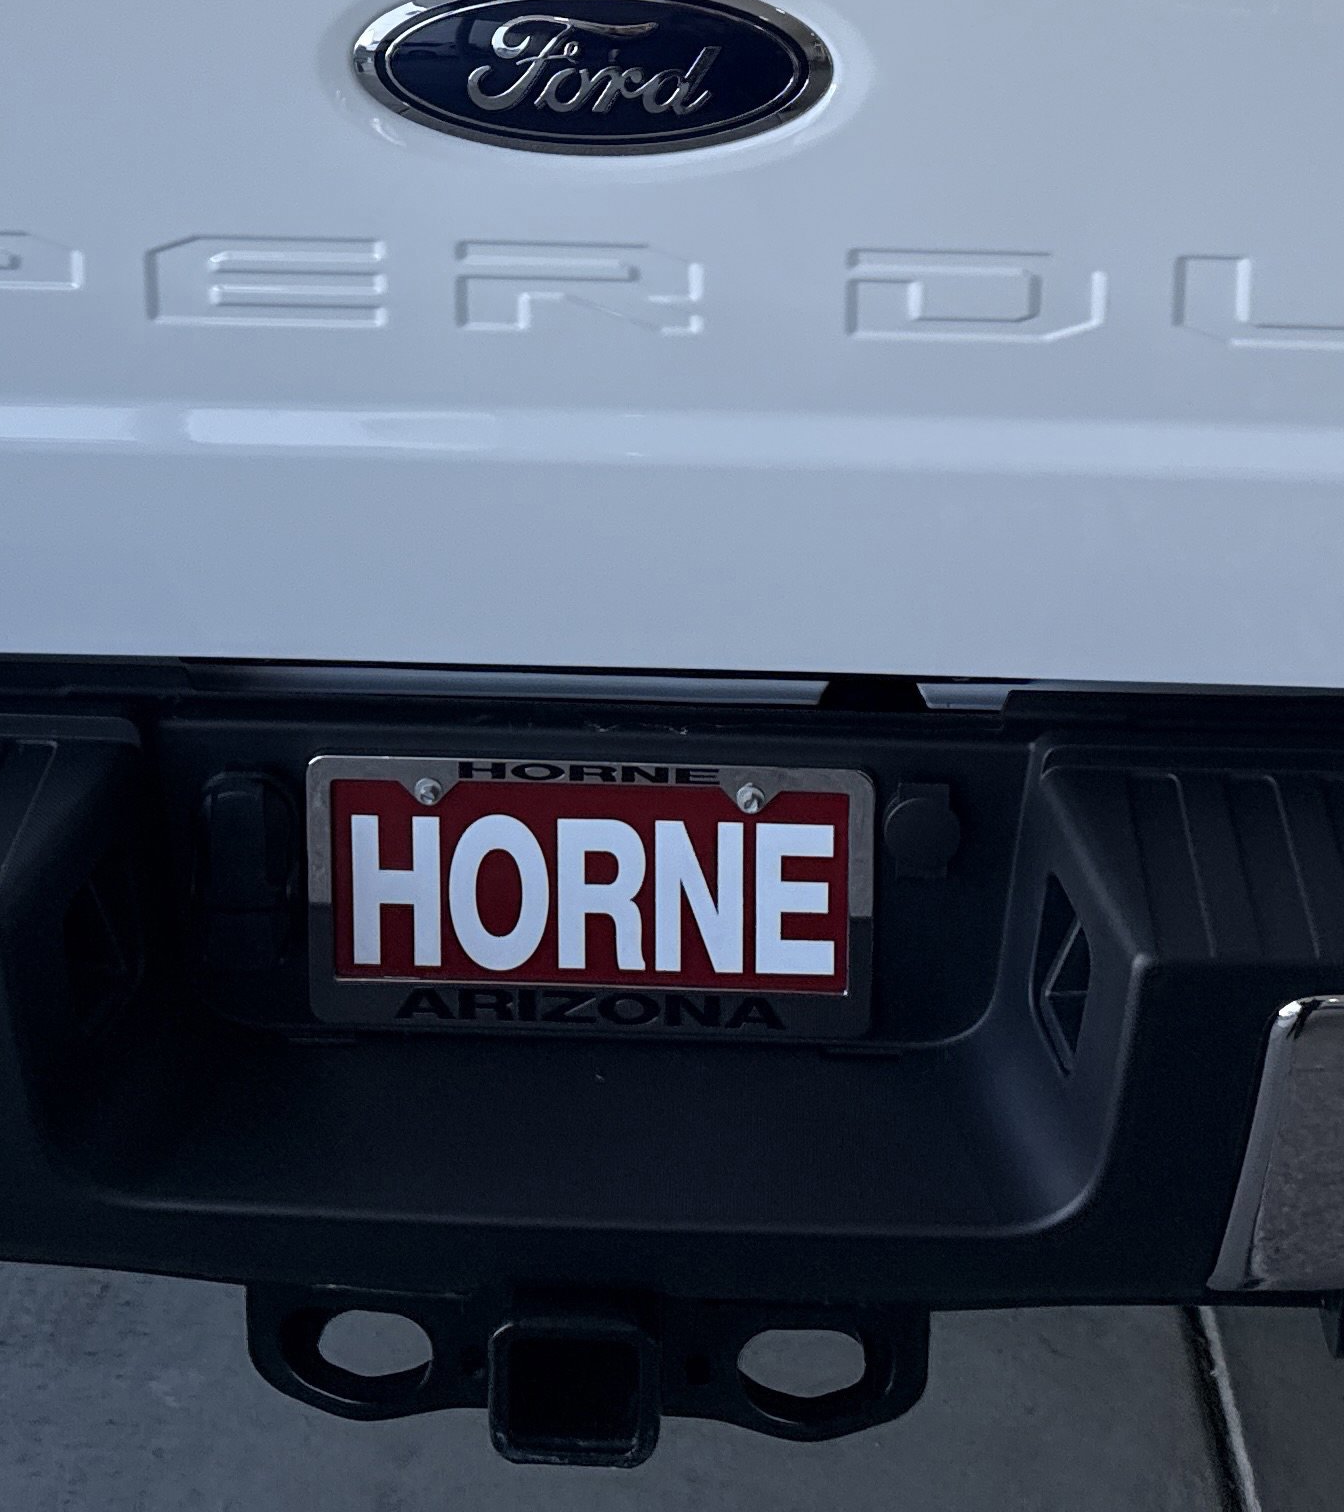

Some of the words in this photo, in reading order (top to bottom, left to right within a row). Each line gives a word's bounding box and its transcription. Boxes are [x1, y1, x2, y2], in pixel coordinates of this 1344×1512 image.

[466, 13, 723, 116] Ford
[457, 760, 722, 786] HORNE
[350, 813, 836, 976] HORNE
[394, 987, 788, 1032] ARIZONA
